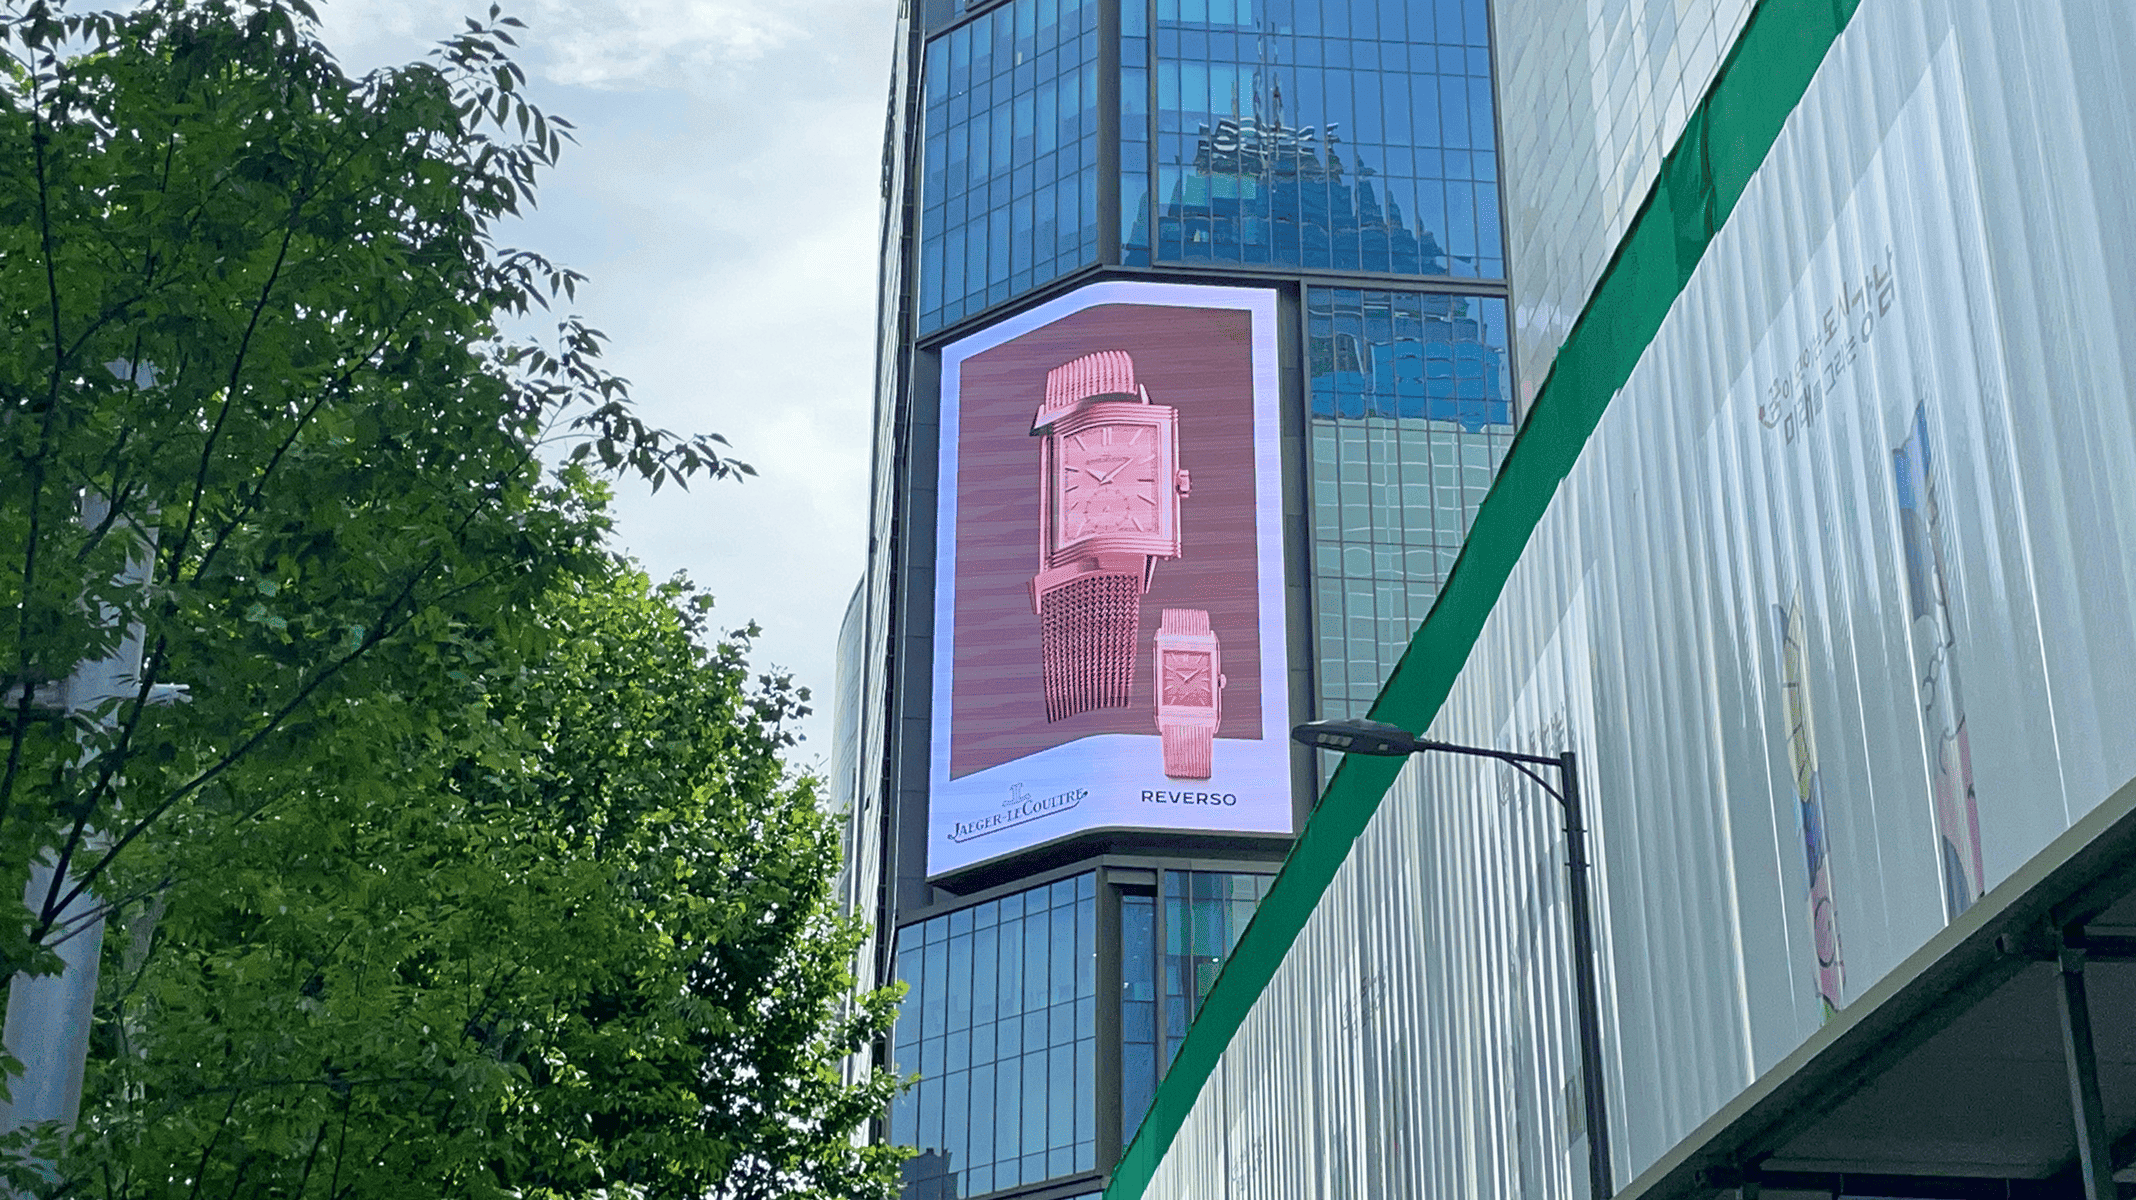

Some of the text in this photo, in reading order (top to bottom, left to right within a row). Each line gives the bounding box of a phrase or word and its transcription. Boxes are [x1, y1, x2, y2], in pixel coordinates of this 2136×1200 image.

[1823, 281, 1849, 346] 도시
[1851, 244, 1895, 344] 강남
[1784, 335, 1857, 445] 미래를 그리는
[1141, 789, 1237, 806] REVERSO
